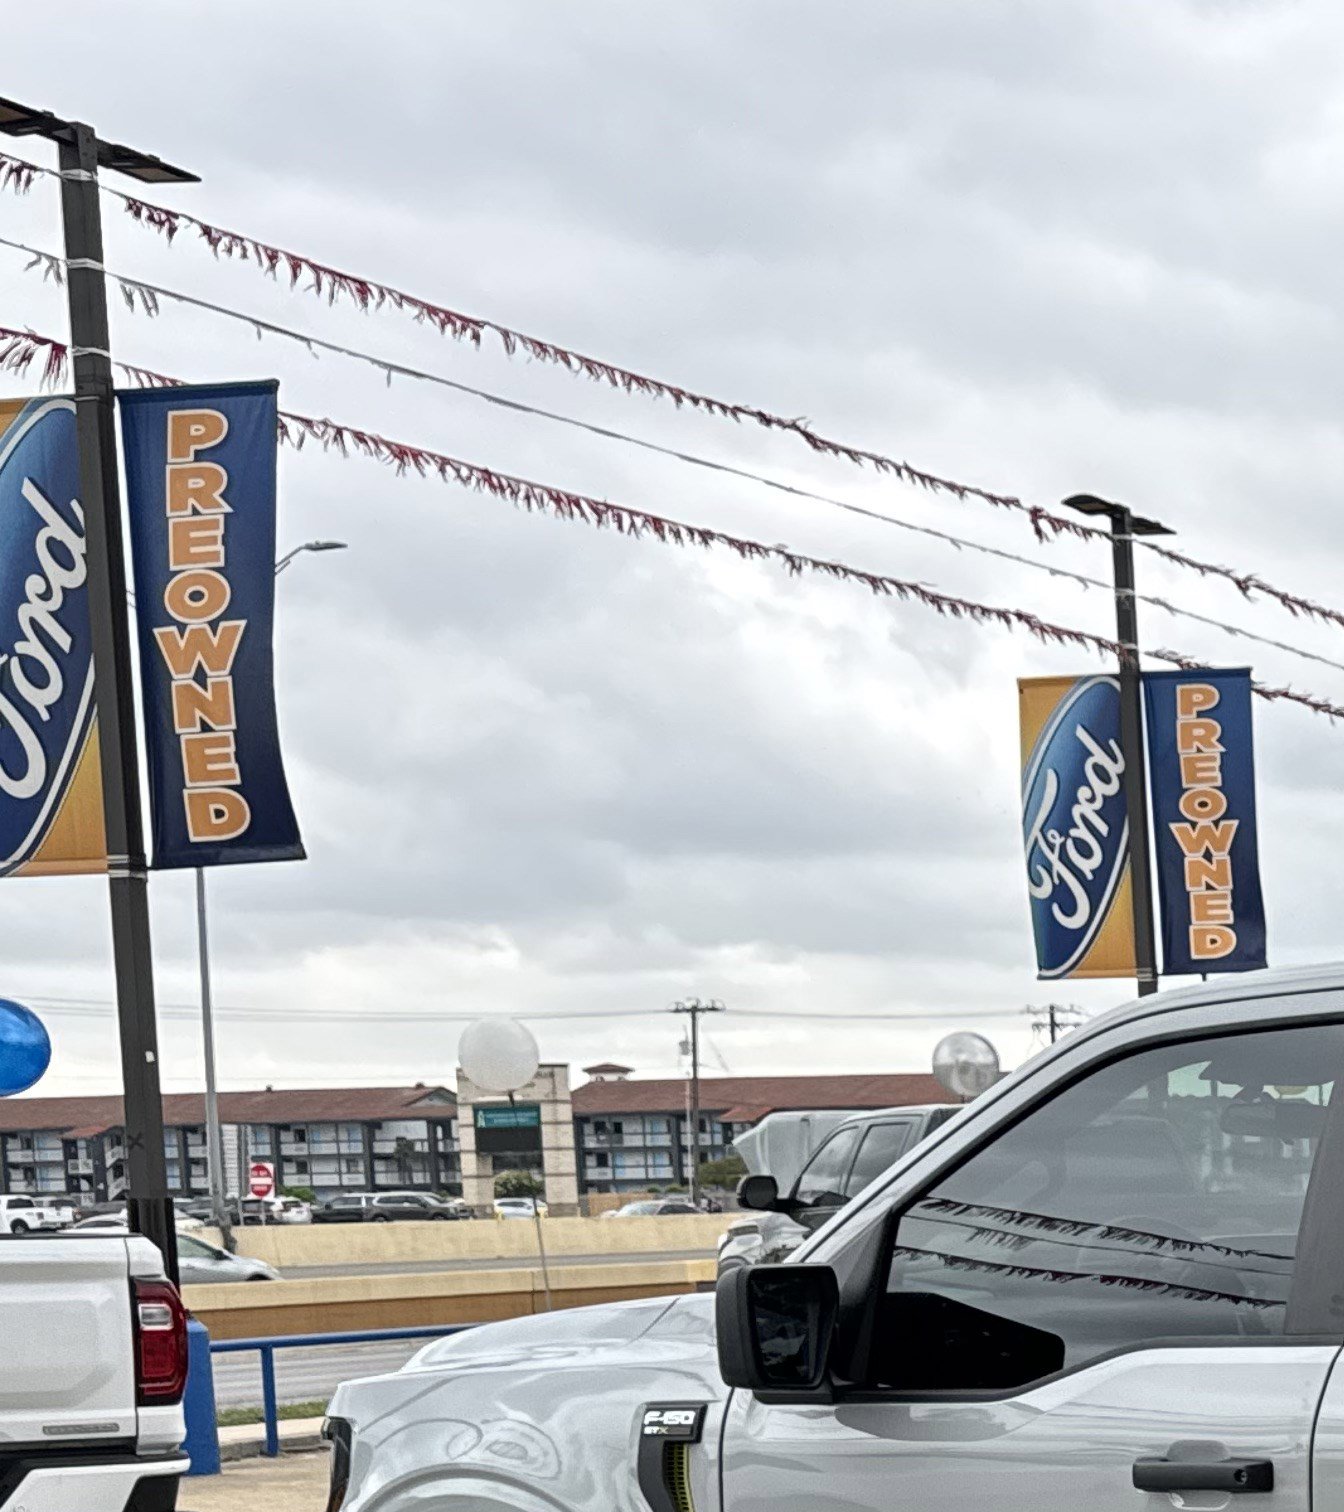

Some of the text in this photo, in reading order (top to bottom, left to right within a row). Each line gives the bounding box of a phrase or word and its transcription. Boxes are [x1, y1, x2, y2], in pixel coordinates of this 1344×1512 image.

[153, 408, 252, 844] PREOWNED
[1027, 722, 1127, 931] Ford
[1168, 682, 1241, 961] PREOWNED
